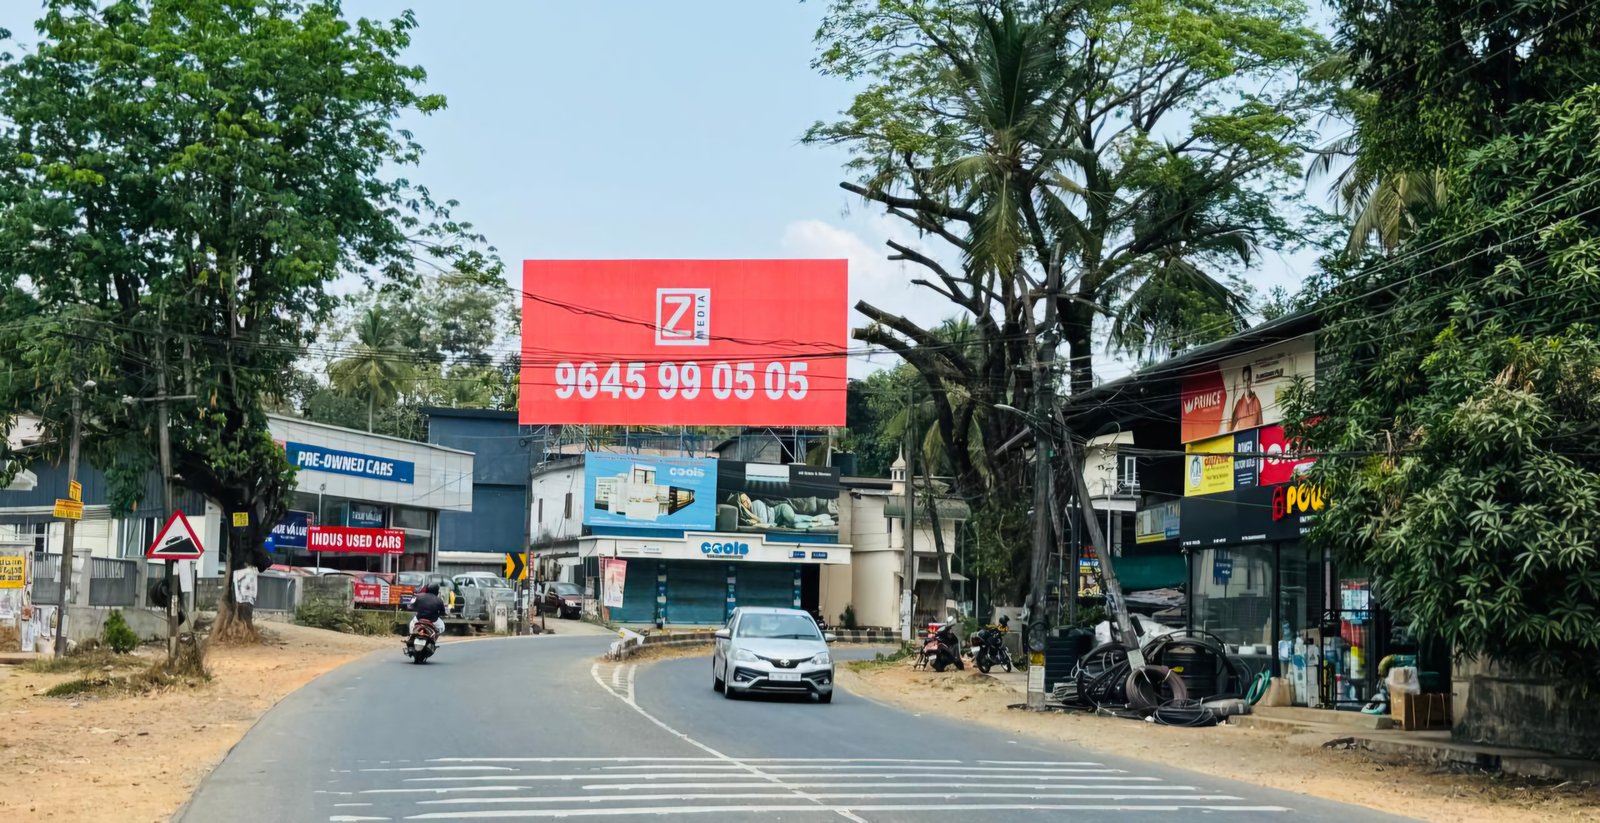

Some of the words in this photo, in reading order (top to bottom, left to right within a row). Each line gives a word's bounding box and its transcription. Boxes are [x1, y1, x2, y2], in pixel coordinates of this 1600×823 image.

[664, 296, 692, 337] Z
[695, 294, 706, 340] MEDIA
[555, 361, 646, 400] 9645
[657, 361, 700, 400] 99
[712, 361, 755, 400] 05
[765, 361, 809, 400] 05
[297, 450, 365, 472] PRE-OWNED
[366, 460, 394, 476] CARS
[286, 521, 308, 536] VALUE
[312, 532, 343, 546] INDUS
[346, 534, 373, 548] USED
[375, 535, 401, 549] CARS
